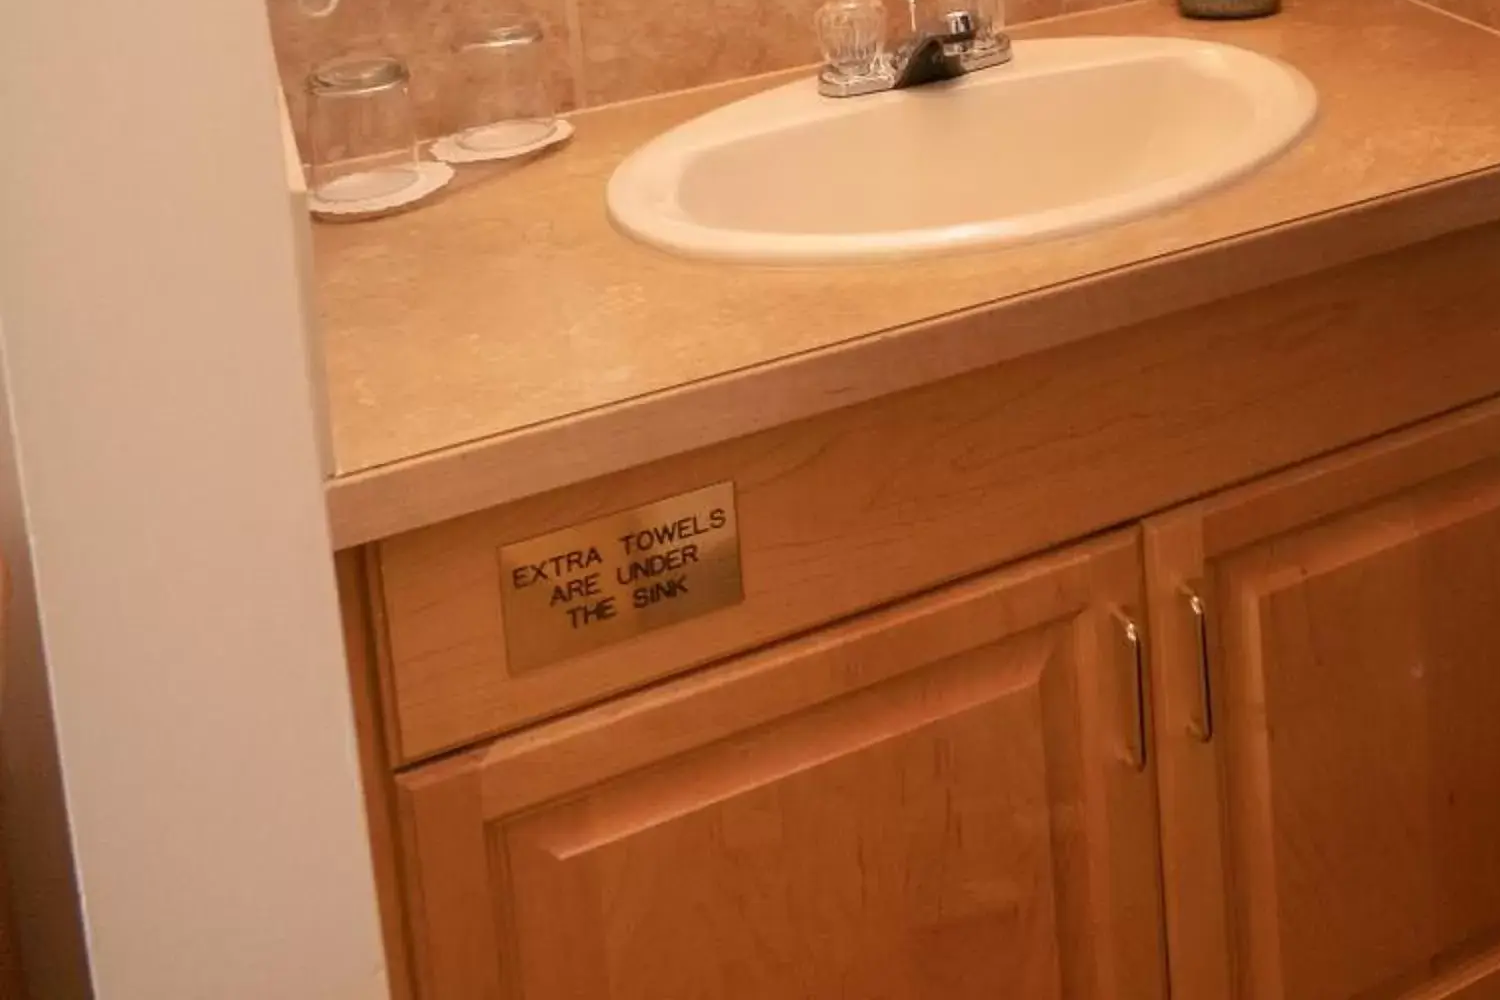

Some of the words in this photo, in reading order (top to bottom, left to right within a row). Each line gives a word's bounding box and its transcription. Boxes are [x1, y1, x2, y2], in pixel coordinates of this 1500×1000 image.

[512, 546, 603, 590] EXTRA
[619, 508, 727, 555] TOWELS
[550, 573, 601, 607] ARE
[616, 544, 700, 586] UNDER
[566, 596, 617, 630] THE
[632, 575, 688, 609] SINK
